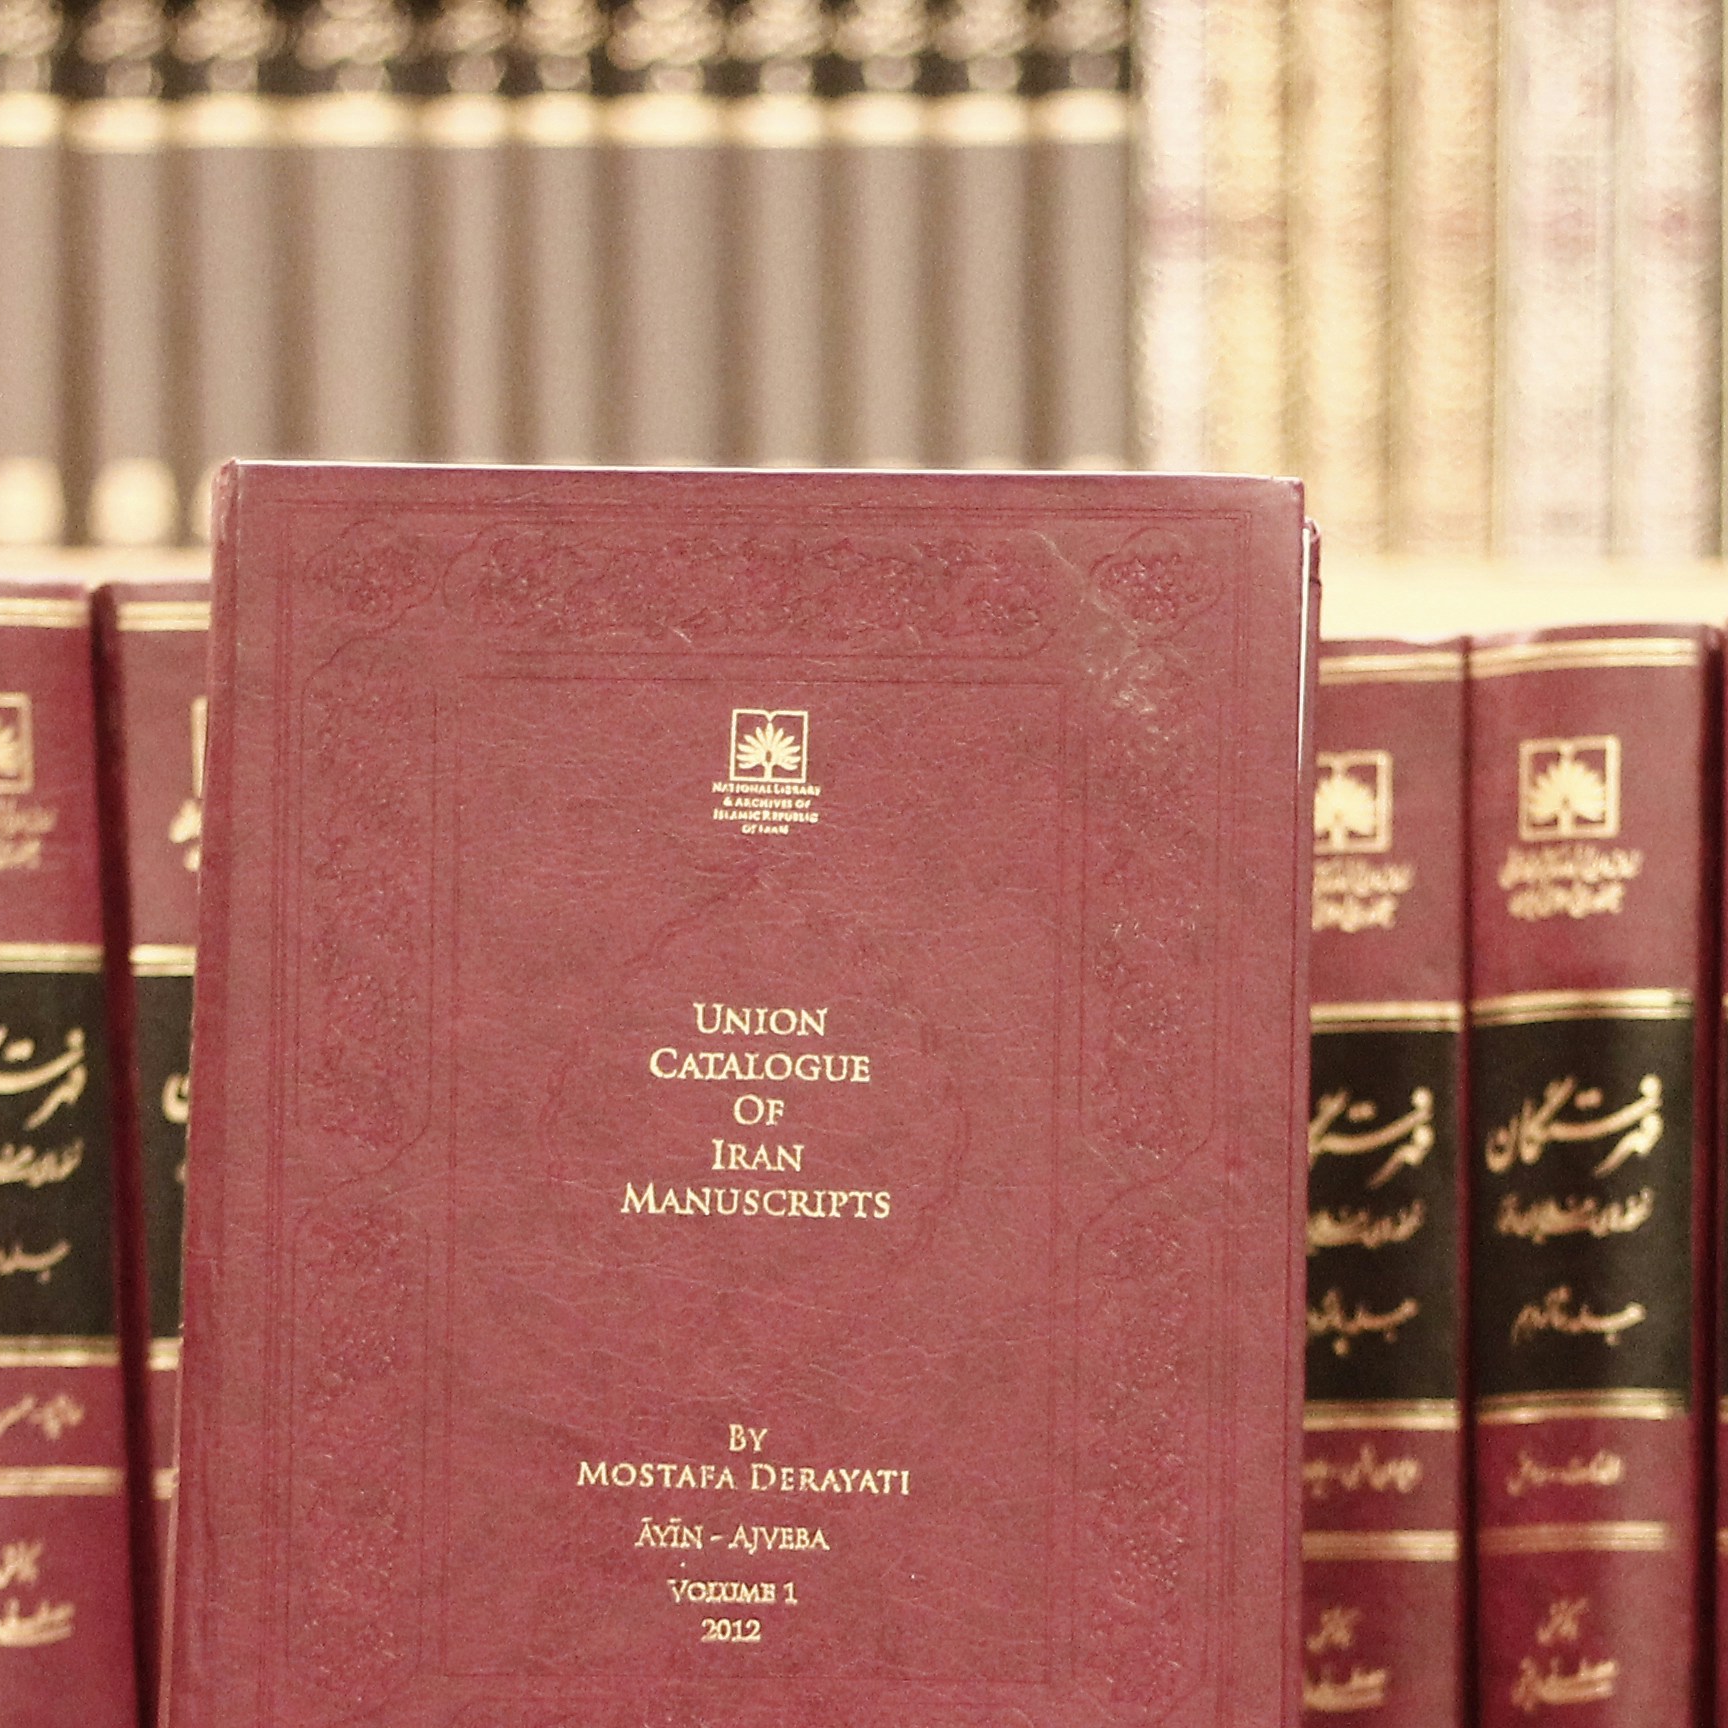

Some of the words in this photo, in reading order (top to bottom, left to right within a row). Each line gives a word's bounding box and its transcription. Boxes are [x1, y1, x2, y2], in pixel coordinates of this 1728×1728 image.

[734, 797, 793, 809] ARCHIVES
[693, 1002, 828, 1037] UNION
[648, 1047, 872, 1083] CATALOGUE
[733, 1093, 785, 1127] OF
[710, 1137, 805, 1173] IRAN
[619, 1180, 892, 1220] MANUSCRIPTS
[728, 1423, 769, 1453] BY
[576, 1460, 738, 1490] MOSTAFA
[749, 1462, 911, 1497] DERAYATI
[727, 1524, 832, 1556] AJVEBA
[666, 1578, 777, 1605] VOLUME
[784, 1581, 799, 1605] 1
[700, 1618, 763, 1643] 2012
